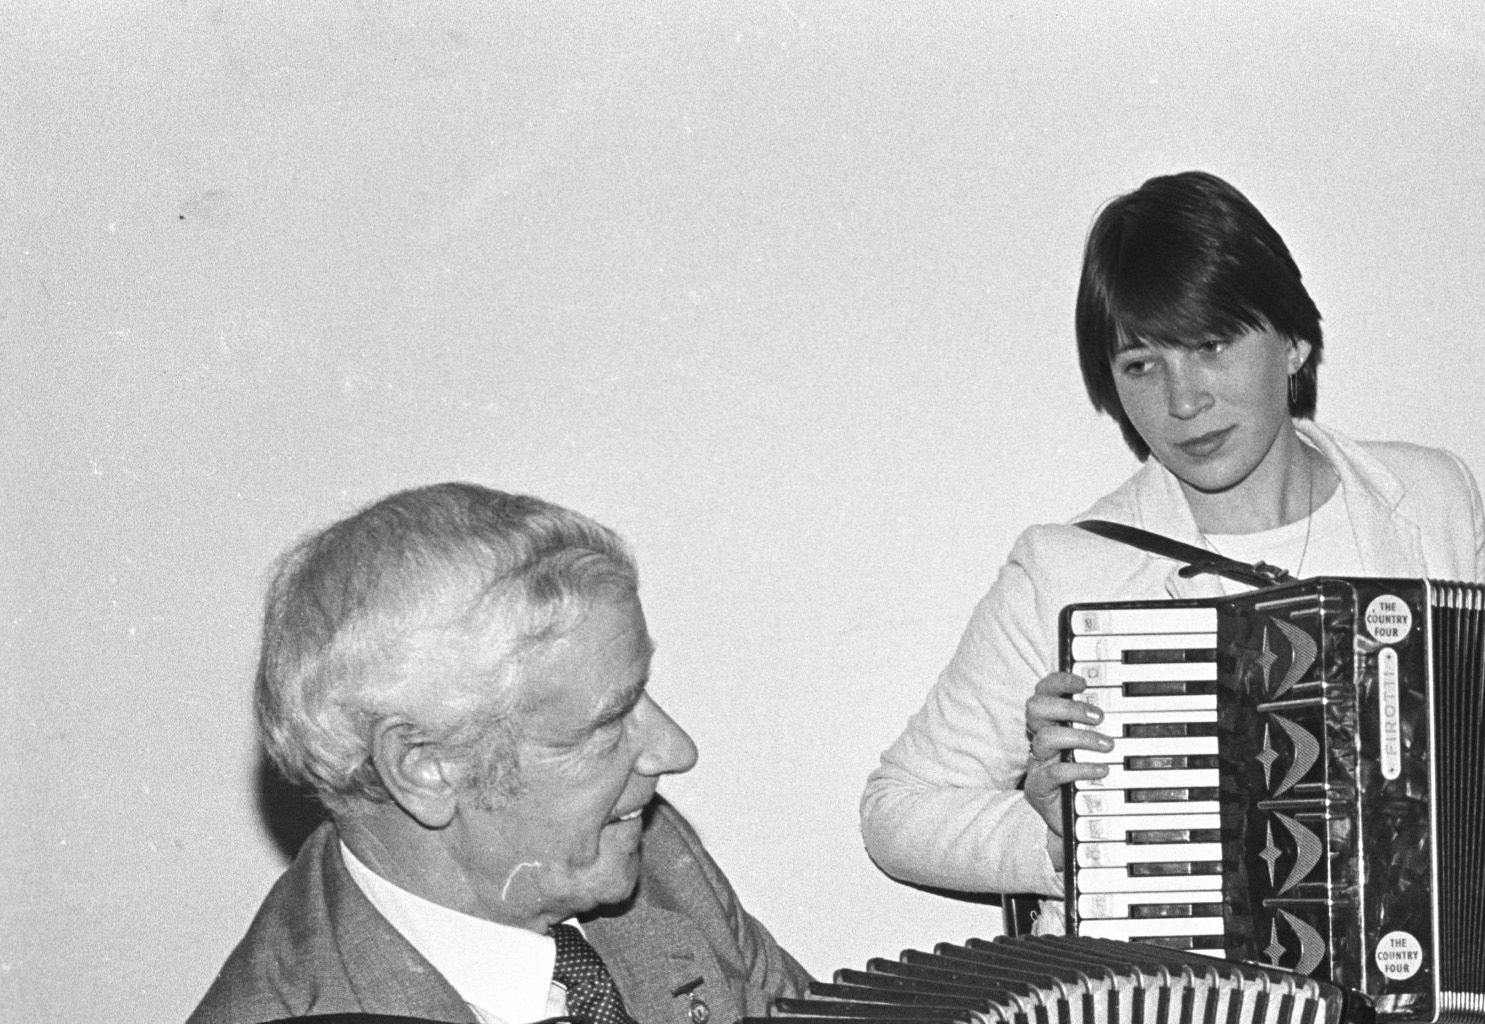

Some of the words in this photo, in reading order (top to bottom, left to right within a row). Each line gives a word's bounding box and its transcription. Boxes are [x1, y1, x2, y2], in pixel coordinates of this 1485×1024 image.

[1380, 602, 1396, 611] THE
[1367, 614, 1408, 624] COUNTRY
[1374, 627, 1398, 637] FOUR
[1390, 939, 1407, 948] THE
[1377, 951, 1418, 960] COUNTRY
[1385, 964, 1409, 973] FOUR
